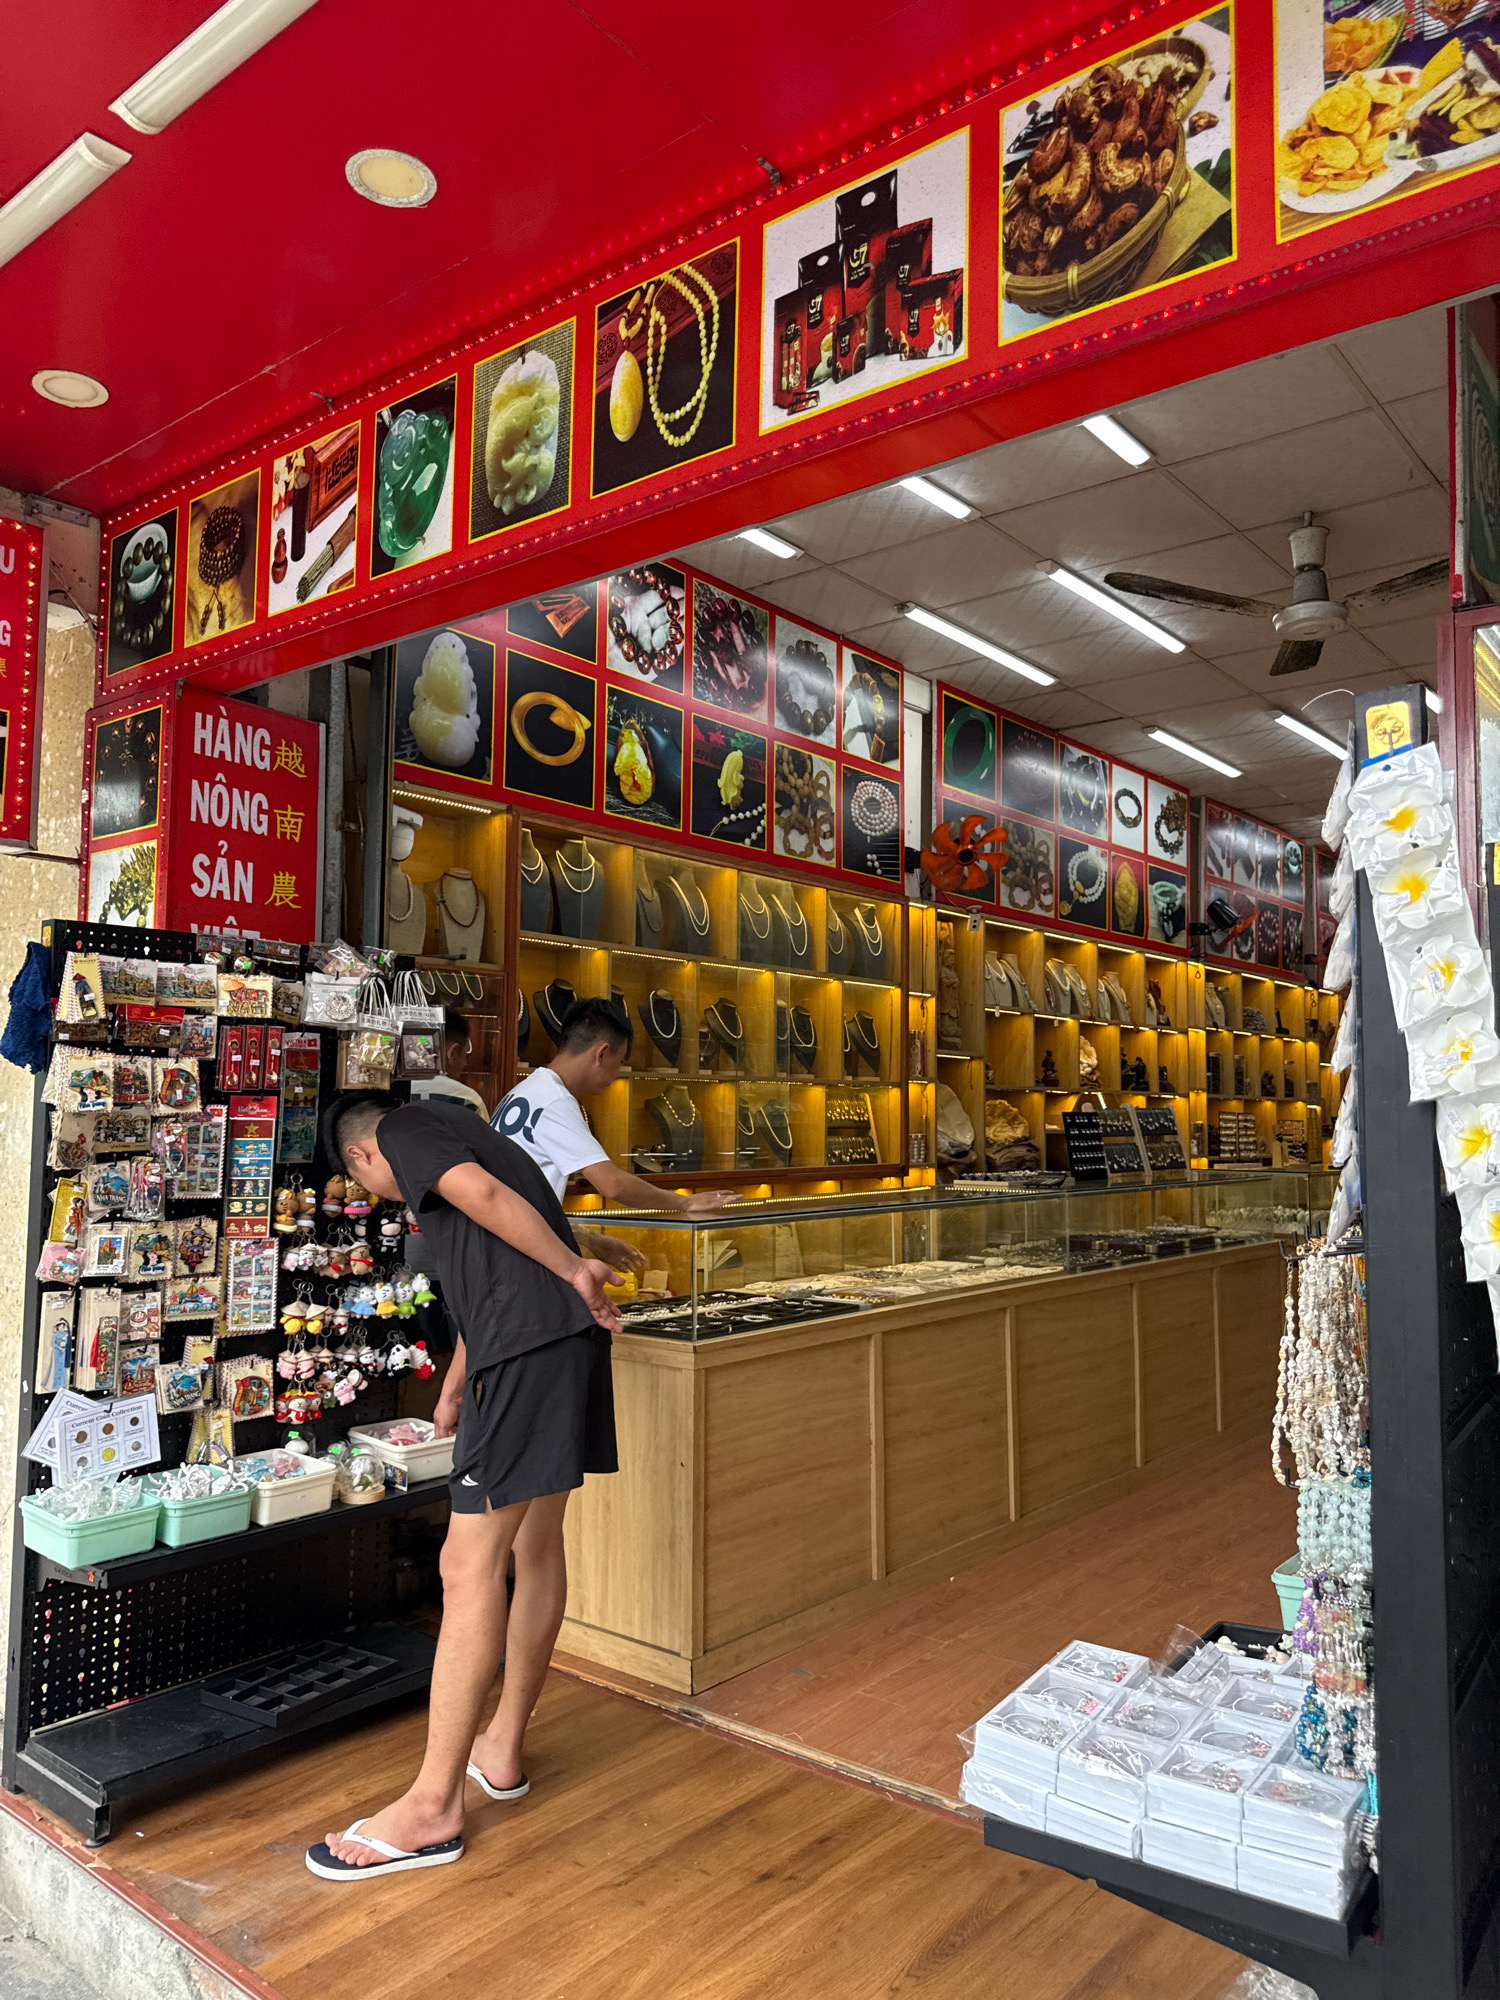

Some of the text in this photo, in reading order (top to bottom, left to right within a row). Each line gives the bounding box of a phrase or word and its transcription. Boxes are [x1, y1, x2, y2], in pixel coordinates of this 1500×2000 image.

[194, 705, 271, 772] HÀNG
[190, 772, 269, 836] NÔNG
[190, 840, 254, 904] SẢN
[71, 1417, 95, 1429] Current
[111, 1405, 143, 1417] Collection
